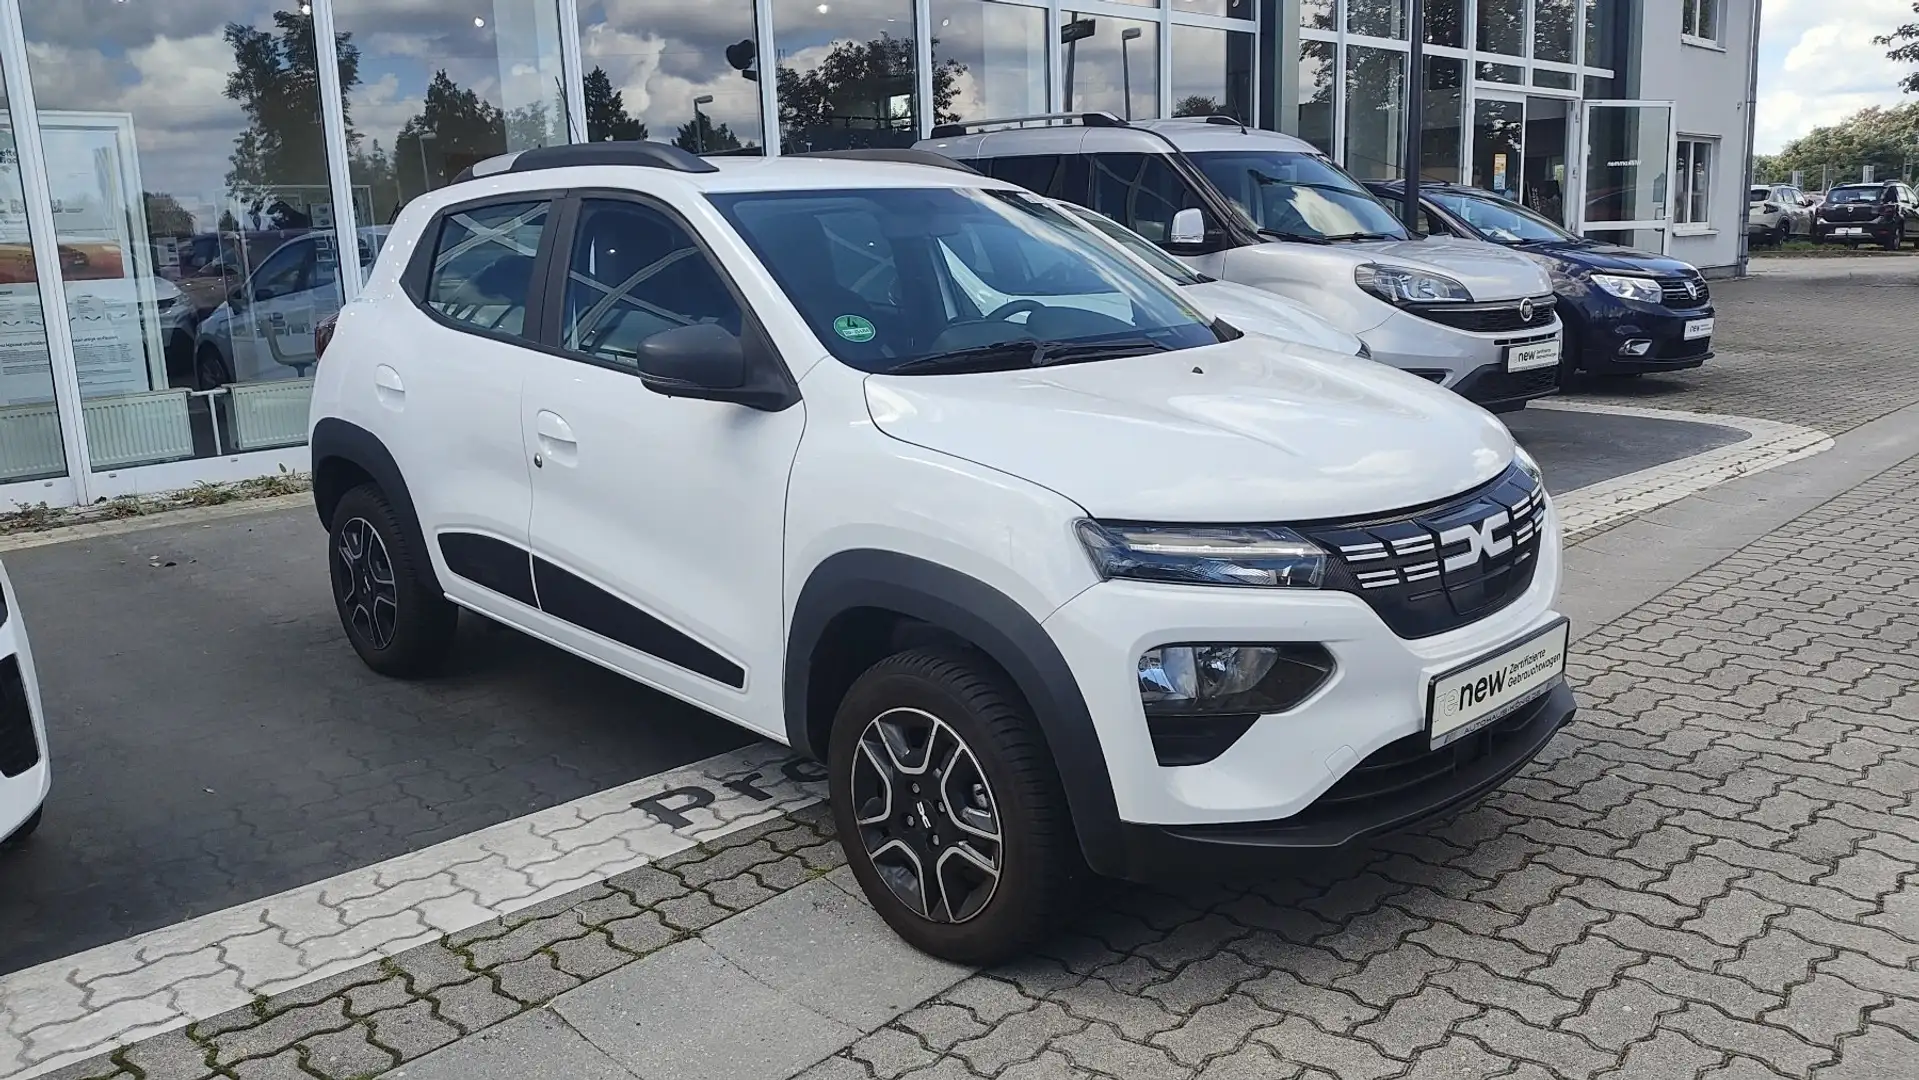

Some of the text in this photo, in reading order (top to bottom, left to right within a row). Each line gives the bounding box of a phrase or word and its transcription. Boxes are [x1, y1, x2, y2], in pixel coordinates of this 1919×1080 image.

[847, 317, 858, 328] 4
[1507, 653, 1561, 687] Gebrauchtwagen
[1509, 649, 1546, 675] Zertifizierte
